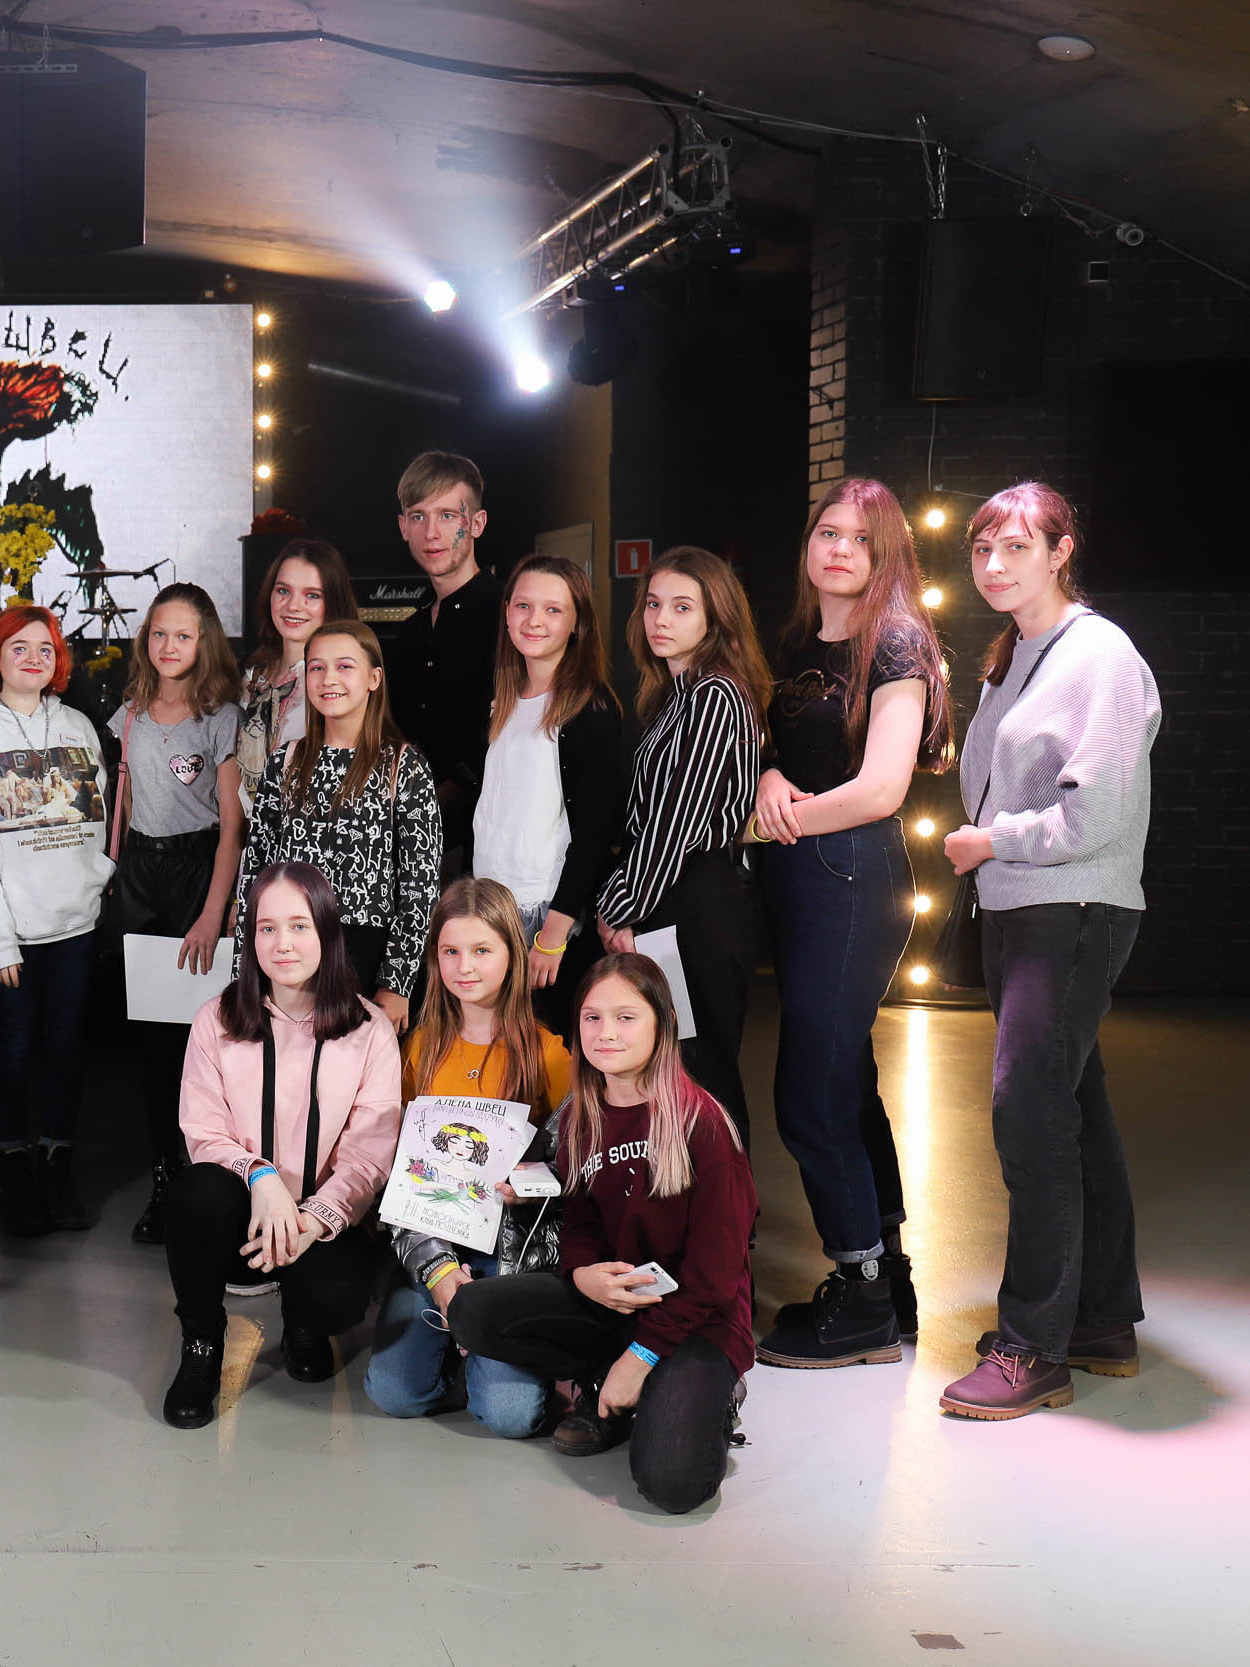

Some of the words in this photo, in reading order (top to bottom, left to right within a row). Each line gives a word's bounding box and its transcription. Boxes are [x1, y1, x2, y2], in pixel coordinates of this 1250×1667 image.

[368, 584, 426, 600] Marshall
[475, 1101, 507, 1117] ШВЕЦ
[581, 1152, 603, 1183] THE
